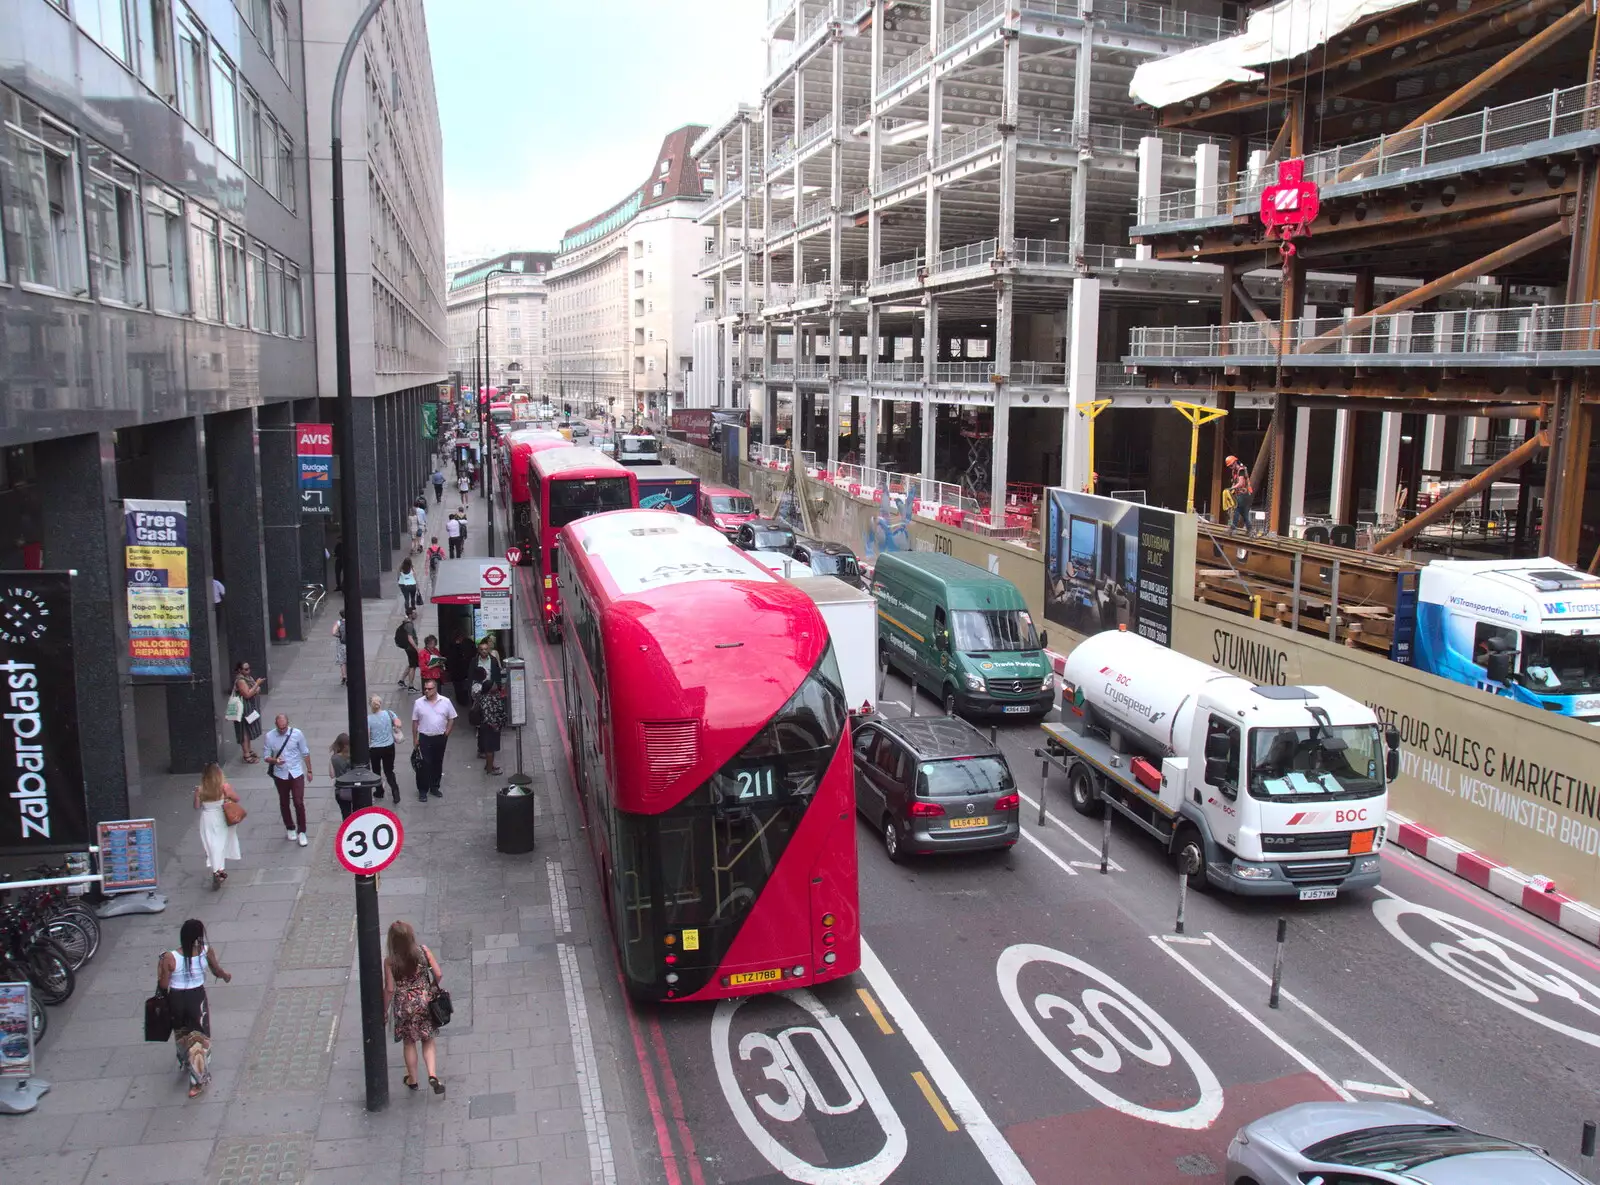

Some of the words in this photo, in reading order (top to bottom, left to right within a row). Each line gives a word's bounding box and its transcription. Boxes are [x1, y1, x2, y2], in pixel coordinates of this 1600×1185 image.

[300, 434, 330, 445] AVIS
[302, 464, 329, 473] Budget
[136, 512, 177, 528] Free
[136, 526, 178, 541] Cash
[508, 552, 520, 561] W
[1147, 550, 1163, 566] PLACE
[135, 570, 158, 583] 0%
[7, 588, 50, 616] INDIAN
[132, 603, 158, 611] Hop-on
[160, 603, 185, 611] Hop-off
[134, 613, 152, 621] Open
[154, 613, 165, 621] Top
[132, 640, 188, 648] UNLOCKING
[135, 647, 185, 657] REPAIRING
[1212, 629, 1287, 687] STUNNING
[1016, 660, 1041, 668] Perkins
[1115, 674, 1132, 687] BOC
[1104, 682, 1152, 718] Cryospeed
[0, 659, 51, 839] zabardast
[1400, 715, 1430, 752] OUR
[1433, 728, 1481, 772] SALES
[1484, 746, 1496, 778] &
[737, 769, 773, 799] 211
[1223, 805, 1237, 817] BOC
[1335, 808, 1368, 823] BOC
[1422, 759, 1458, 797] HALL,
[1460, 772, 1556, 838] WESTMINSTER
[1559, 815, 1600, 860] BRID
[346, 823, 394, 858] 30
[1264, 837, 1296, 846] DAF
[736, 970, 776, 984] LTZ1788
[1034, 988, 1172, 1074] 30
[738, 1026, 865, 1122] 30
